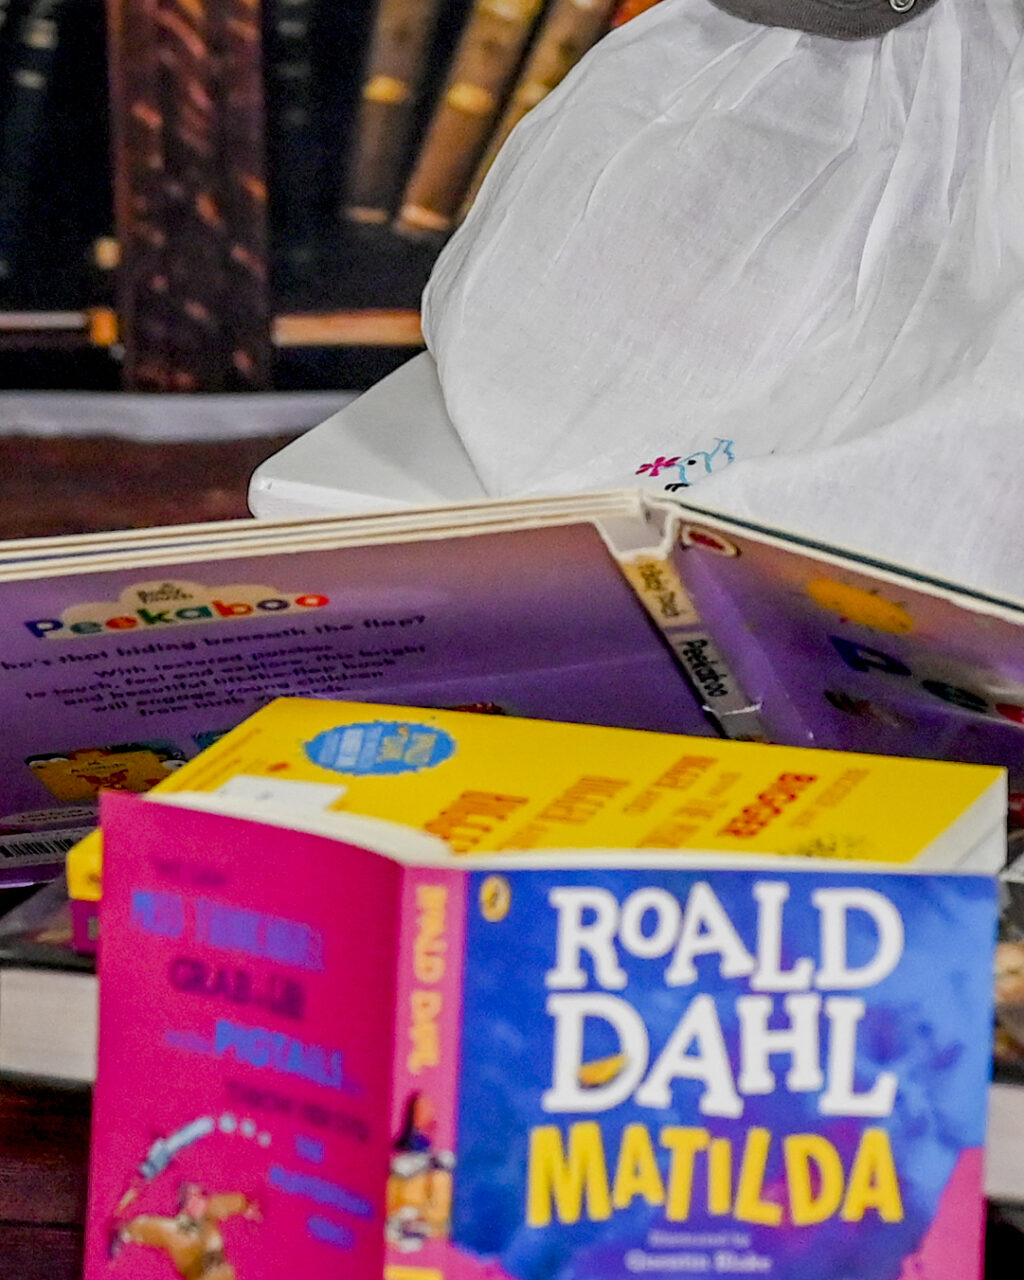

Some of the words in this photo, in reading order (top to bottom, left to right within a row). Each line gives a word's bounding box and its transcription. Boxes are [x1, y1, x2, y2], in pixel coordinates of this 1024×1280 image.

[23, 593, 330, 639] Peekaboo
[545, 881, 904, 993] ROALD
[541, 994, 898, 1118] DAHL
[526, 1120, 904, 1227] MATILDA
